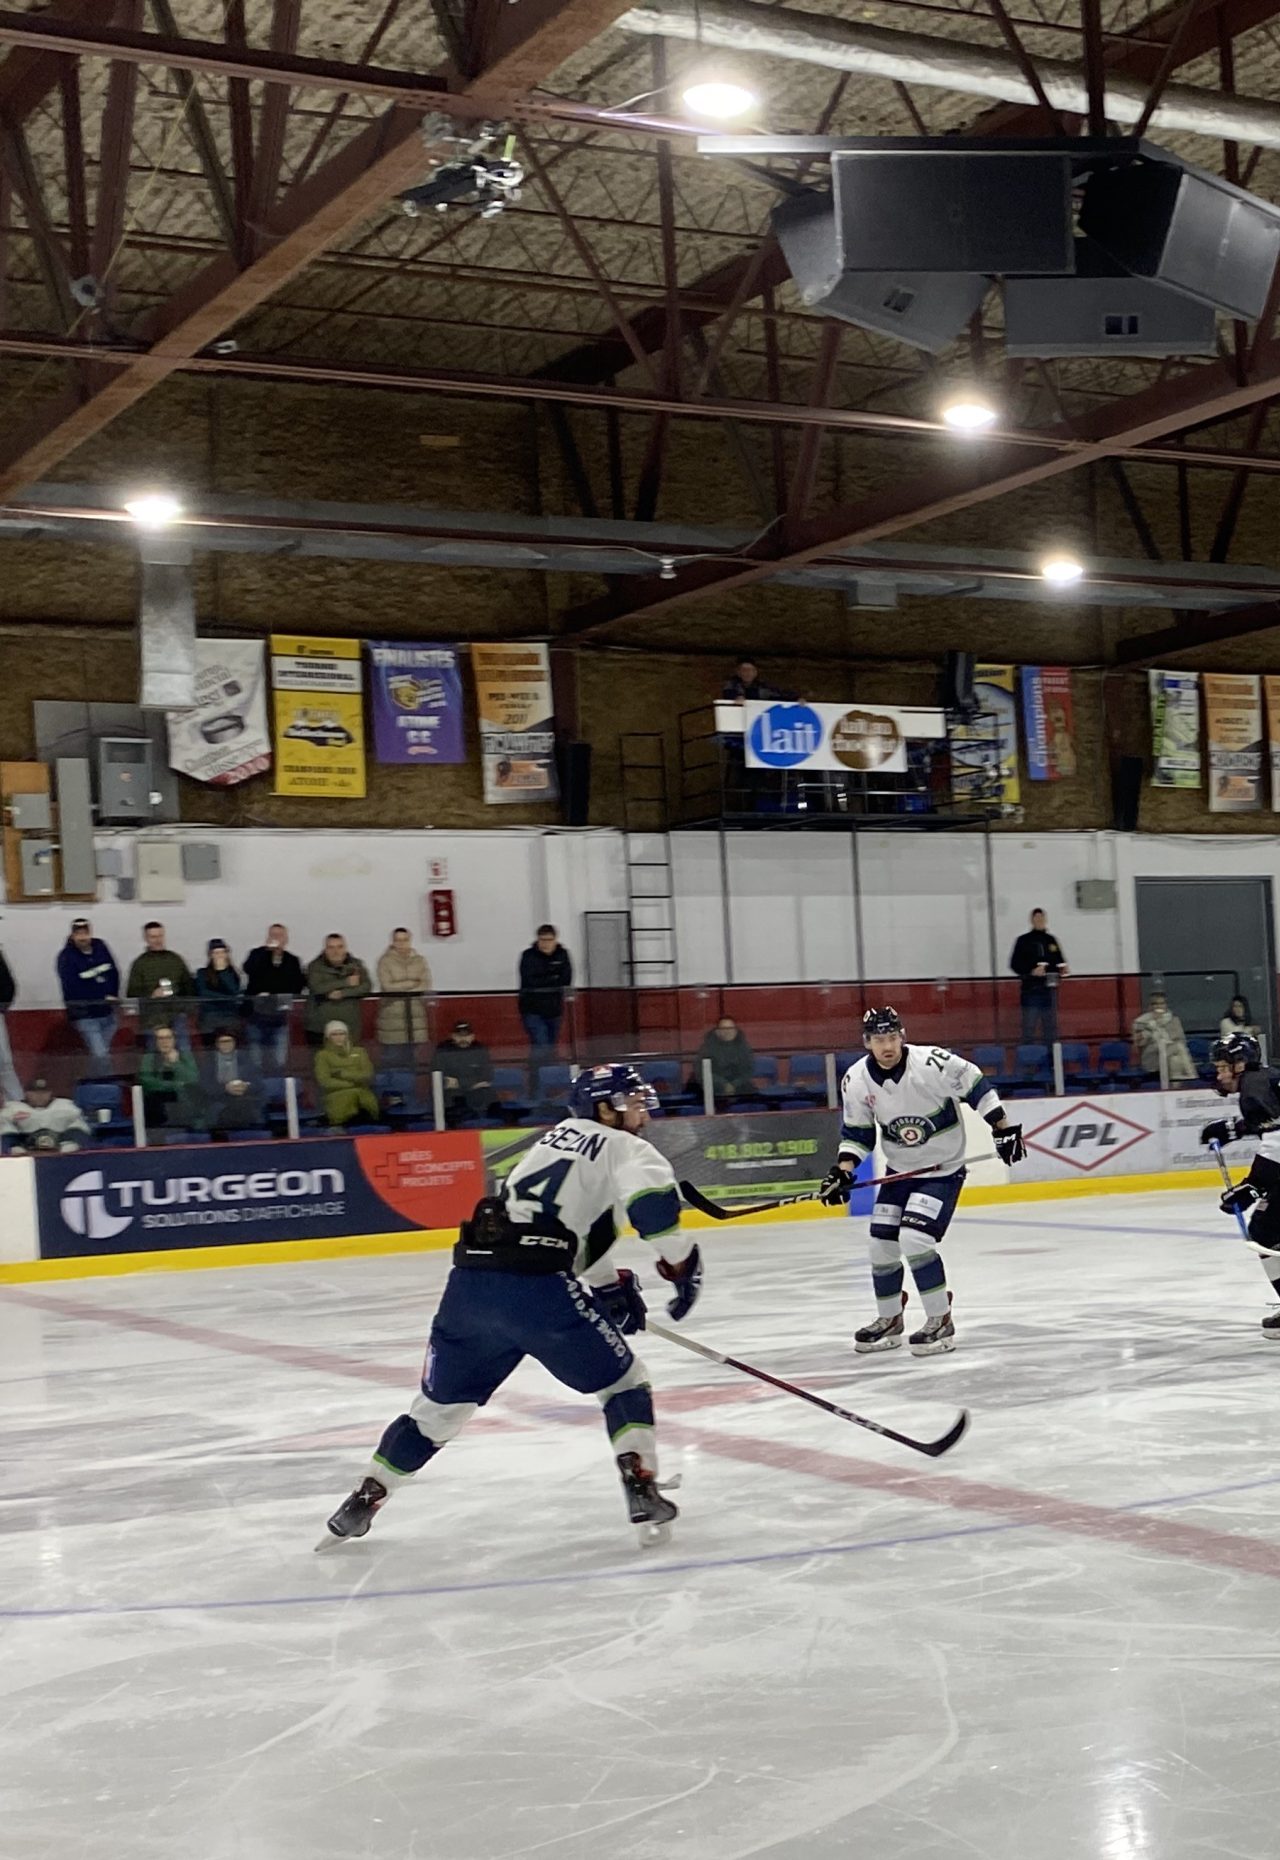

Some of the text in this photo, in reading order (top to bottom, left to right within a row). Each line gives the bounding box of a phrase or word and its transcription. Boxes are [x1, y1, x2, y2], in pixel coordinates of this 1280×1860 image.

[760, 712, 817, 753] lait
[1055, 1123, 1119, 1149] IPL
[108, 1167, 345, 1207] TURGEON
[402, 1174, 453, 1187] PROJETS
[142, 1208, 240, 1229] SOLUTIONS
[519, 1234, 569, 1250] CCM
